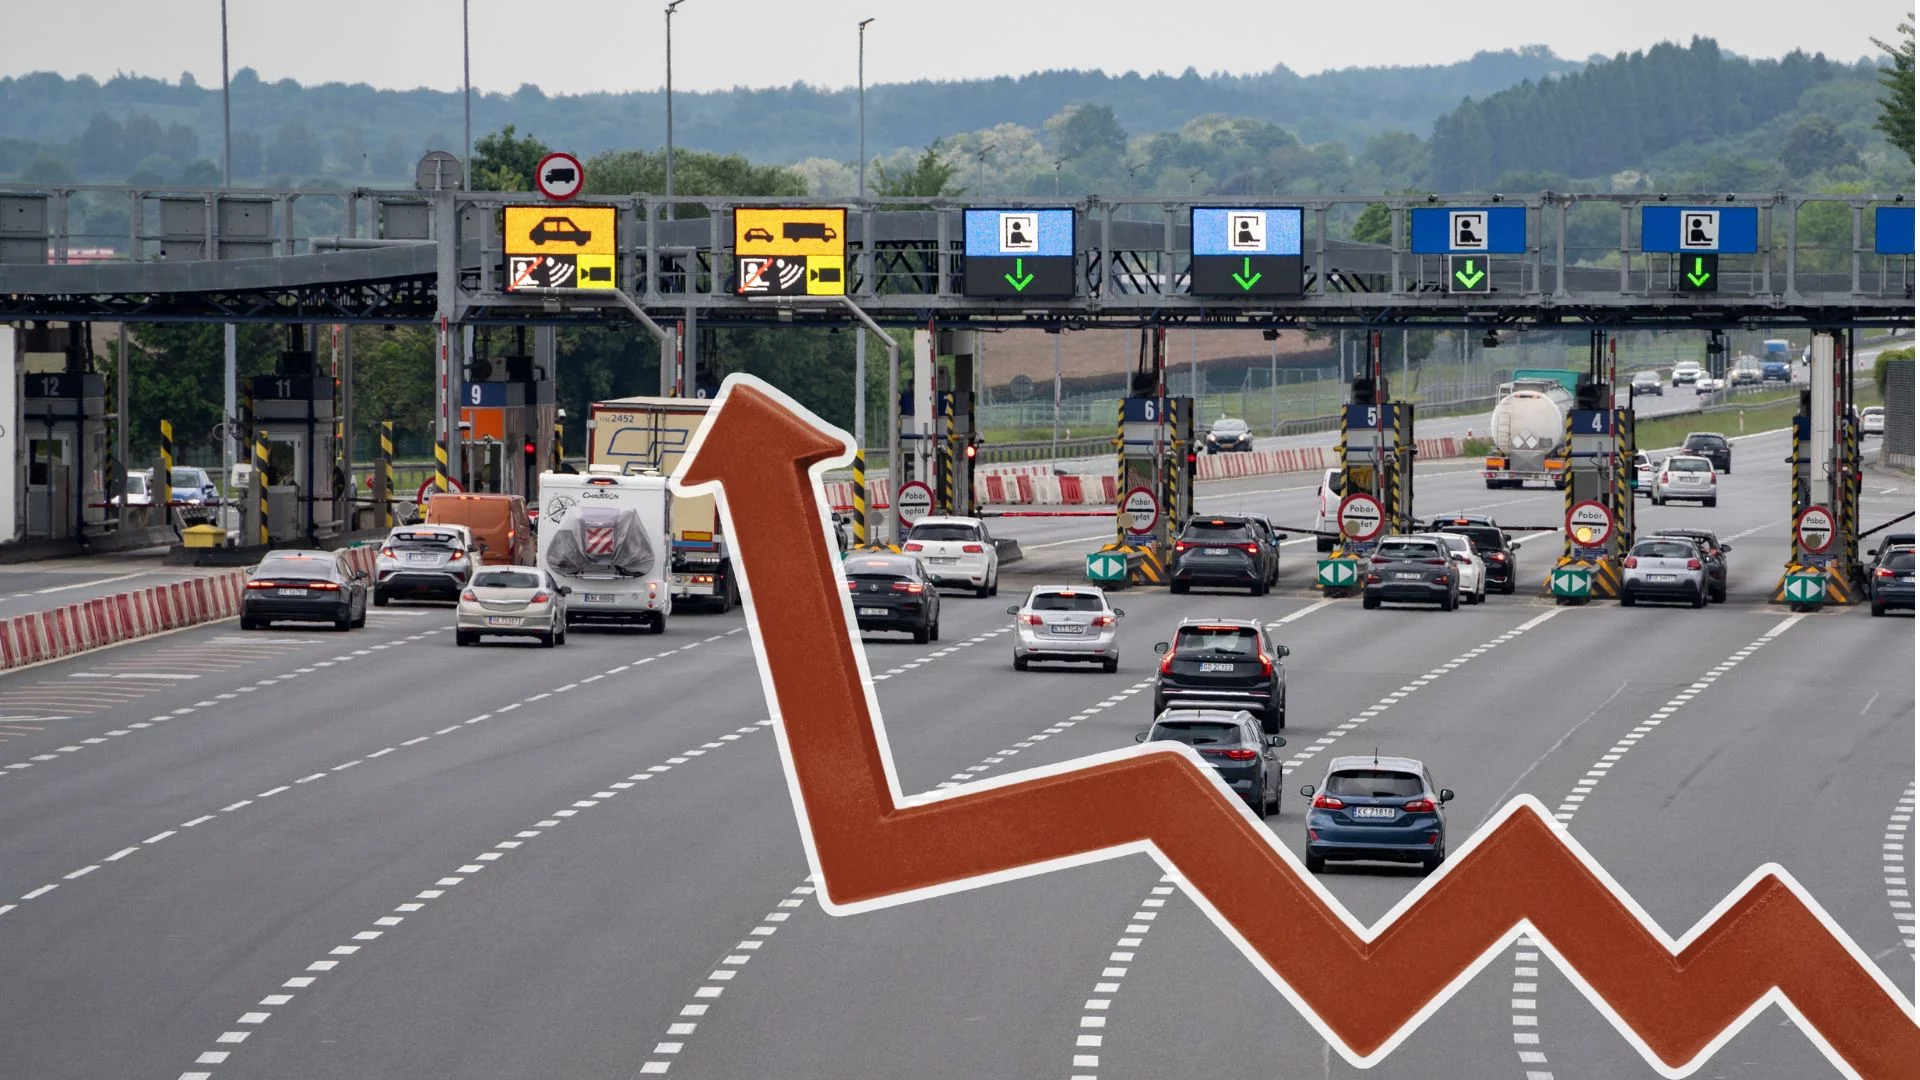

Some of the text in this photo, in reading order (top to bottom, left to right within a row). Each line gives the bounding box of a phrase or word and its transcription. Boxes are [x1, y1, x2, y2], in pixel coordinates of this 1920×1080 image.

[41, 377, 59, 396] 12
[275, 379, 291, 397] 11
[471, 384, 481, 405] 9
[611, 414, 634, 423] 2452
[1144, 400, 1155, 420] 6
[1367, 406, 1377, 427] 5
[1591, 412, 1603, 432] 4
[1357, 807, 1393, 817] KK 71818
